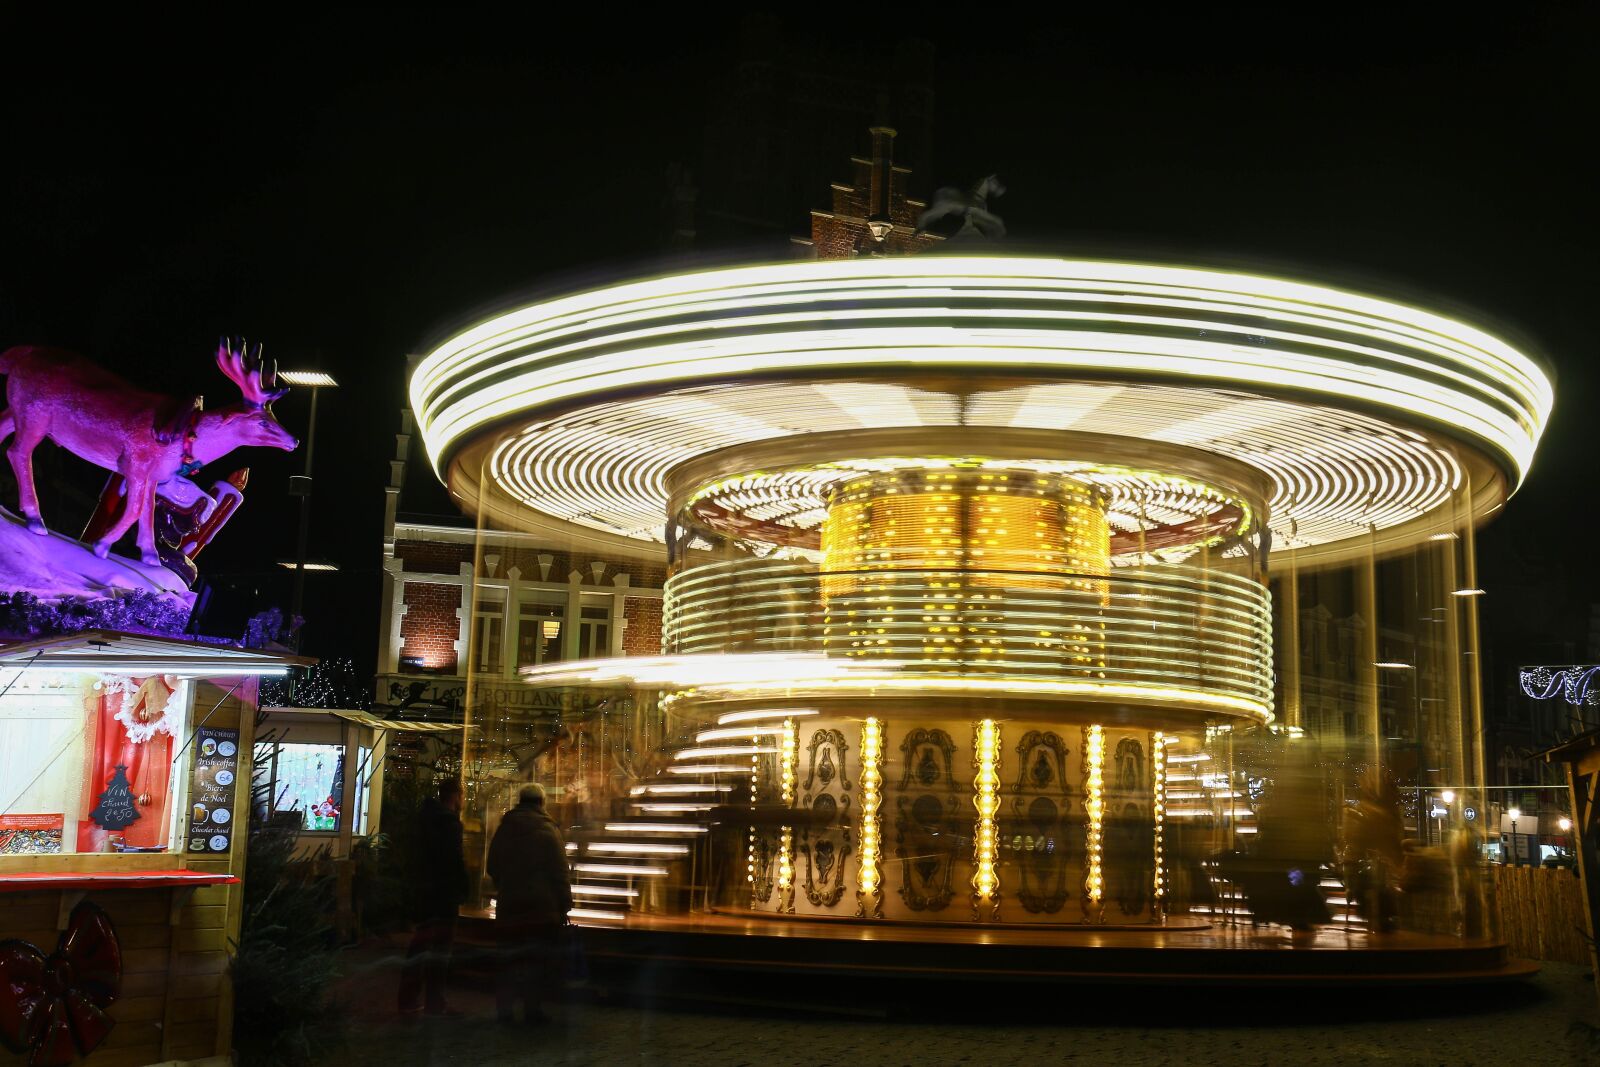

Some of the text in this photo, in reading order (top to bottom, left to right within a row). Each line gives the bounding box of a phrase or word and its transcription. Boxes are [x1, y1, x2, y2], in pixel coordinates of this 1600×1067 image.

[199, 757, 235, 769] Irish coffee
[107, 784, 128, 796] VIN
[200, 793, 209, 802] de
